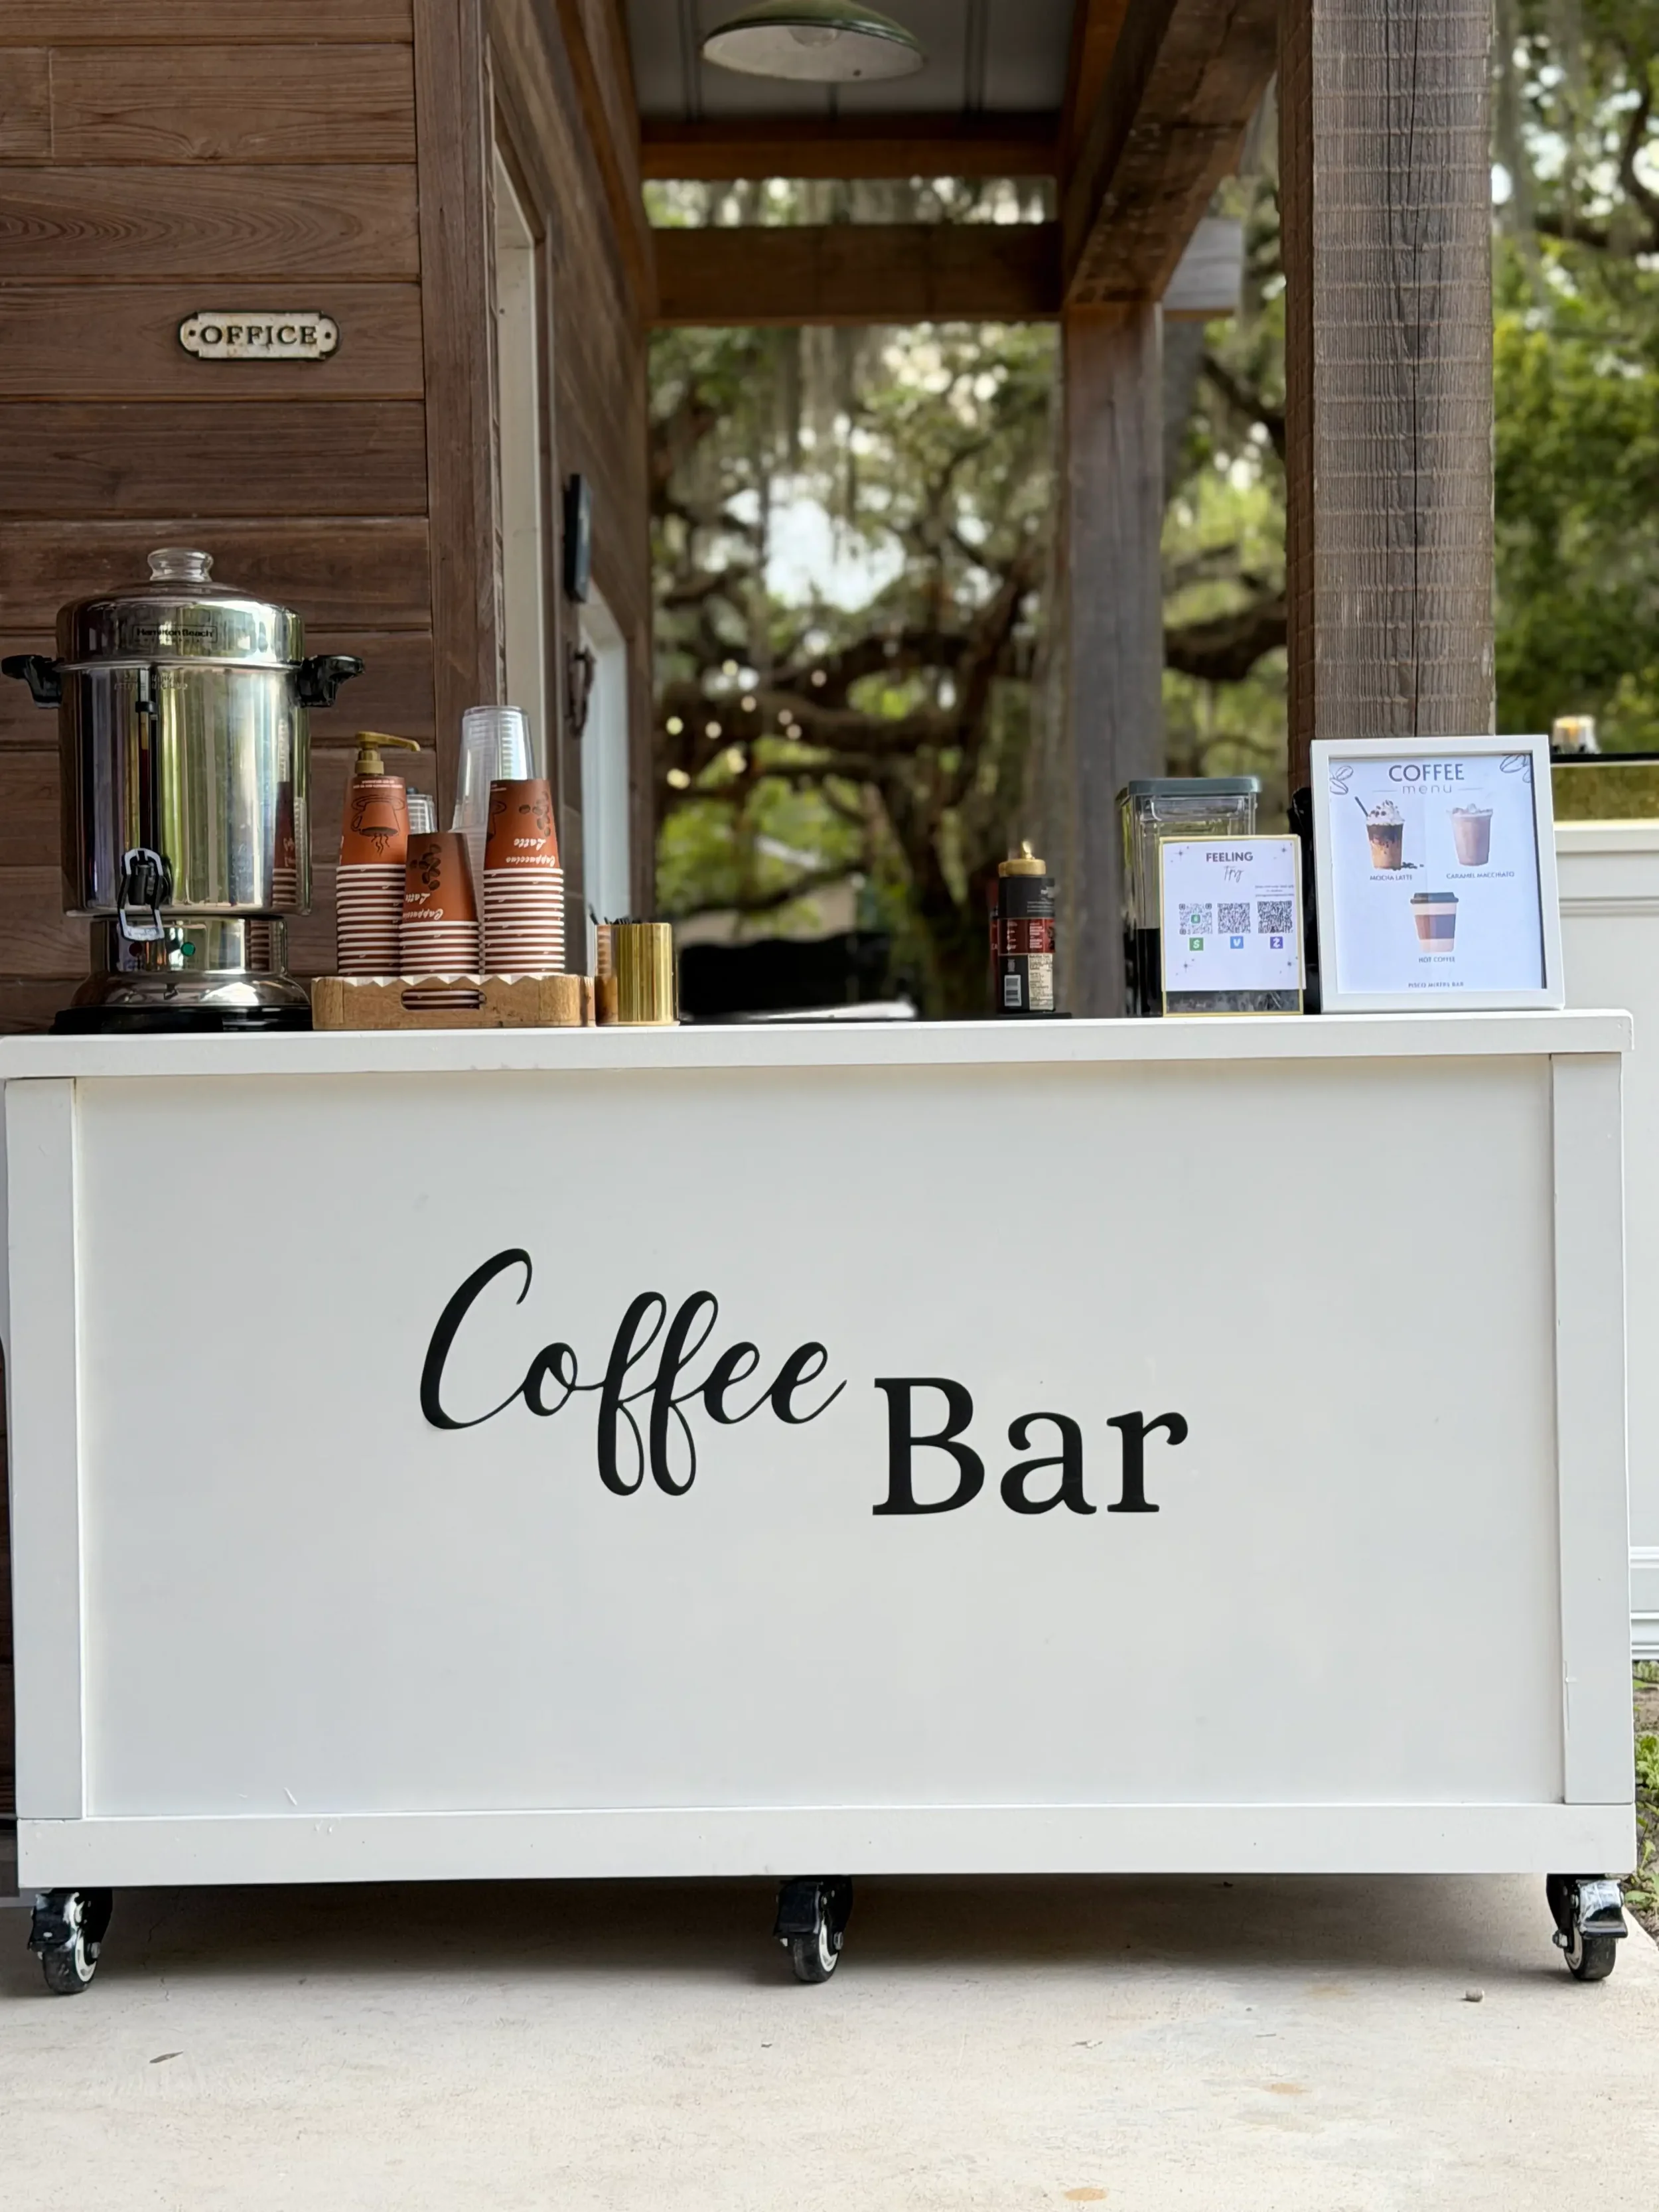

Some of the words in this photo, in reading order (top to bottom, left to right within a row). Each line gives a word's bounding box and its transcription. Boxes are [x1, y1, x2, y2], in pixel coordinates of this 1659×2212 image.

[200, 325, 318, 345] OFFICE
[1388, 763, 1465, 782] COFFEE
[1402, 784, 1453, 795] menu
[514, 838, 546, 850] Latte
[506, 854, 555, 867] Cappuccino
[1206, 851, 1254, 862] FEELING
[420, 1247, 847, 1497] Coffee
[872, 1377, 1189, 1516] Bar
